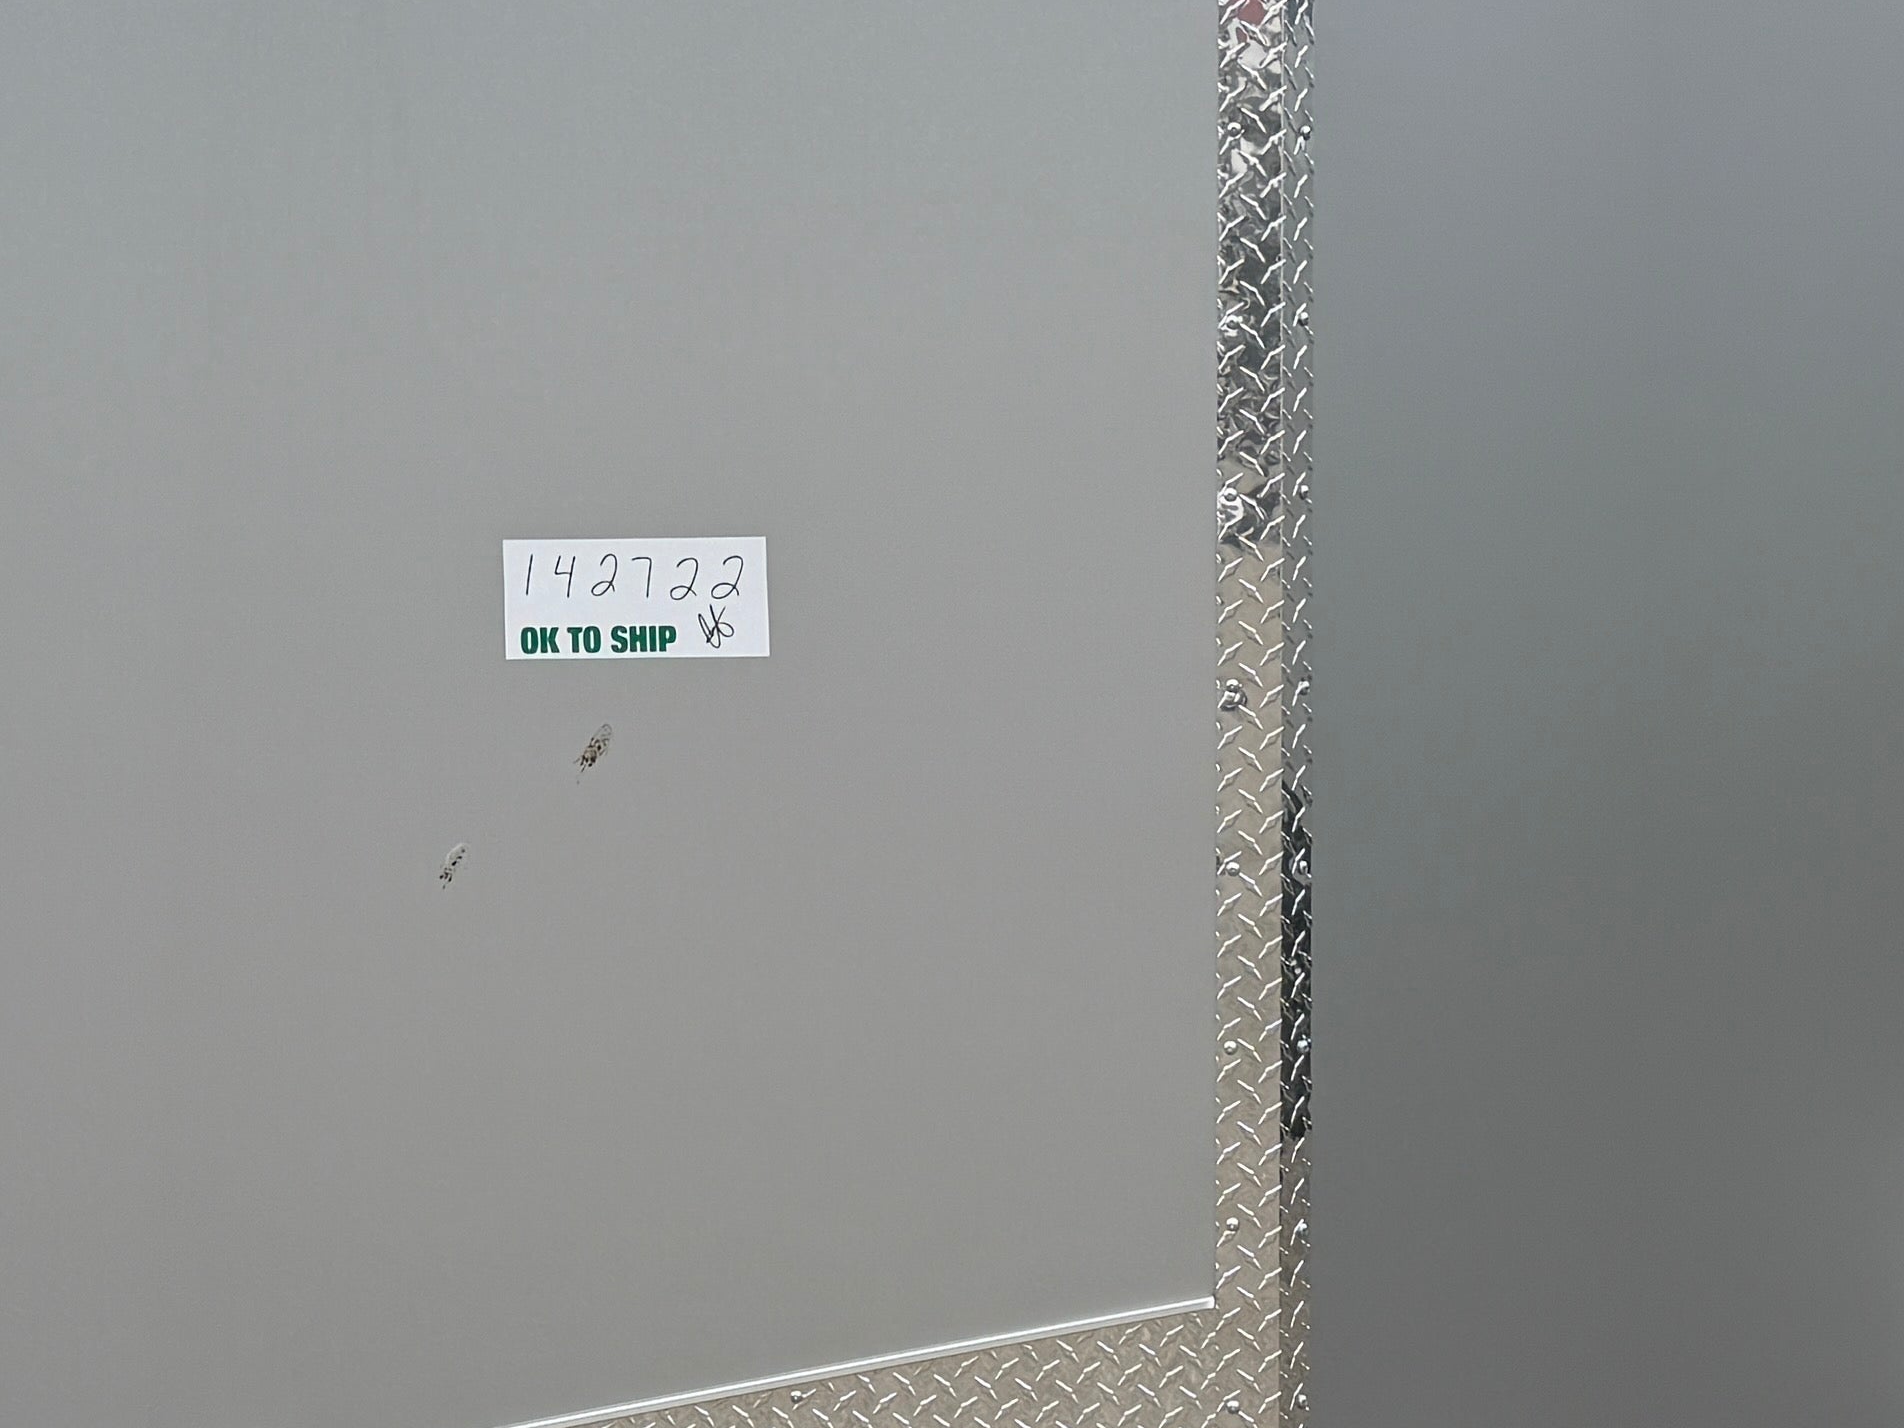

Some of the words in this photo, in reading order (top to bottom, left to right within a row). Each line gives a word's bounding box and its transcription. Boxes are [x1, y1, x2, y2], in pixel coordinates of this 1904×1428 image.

[524, 552, 744, 601] 142722
[520, 626, 560, 655] OK
[567, 625, 602, 654] TO
[610, 624, 677, 653] SHIP
